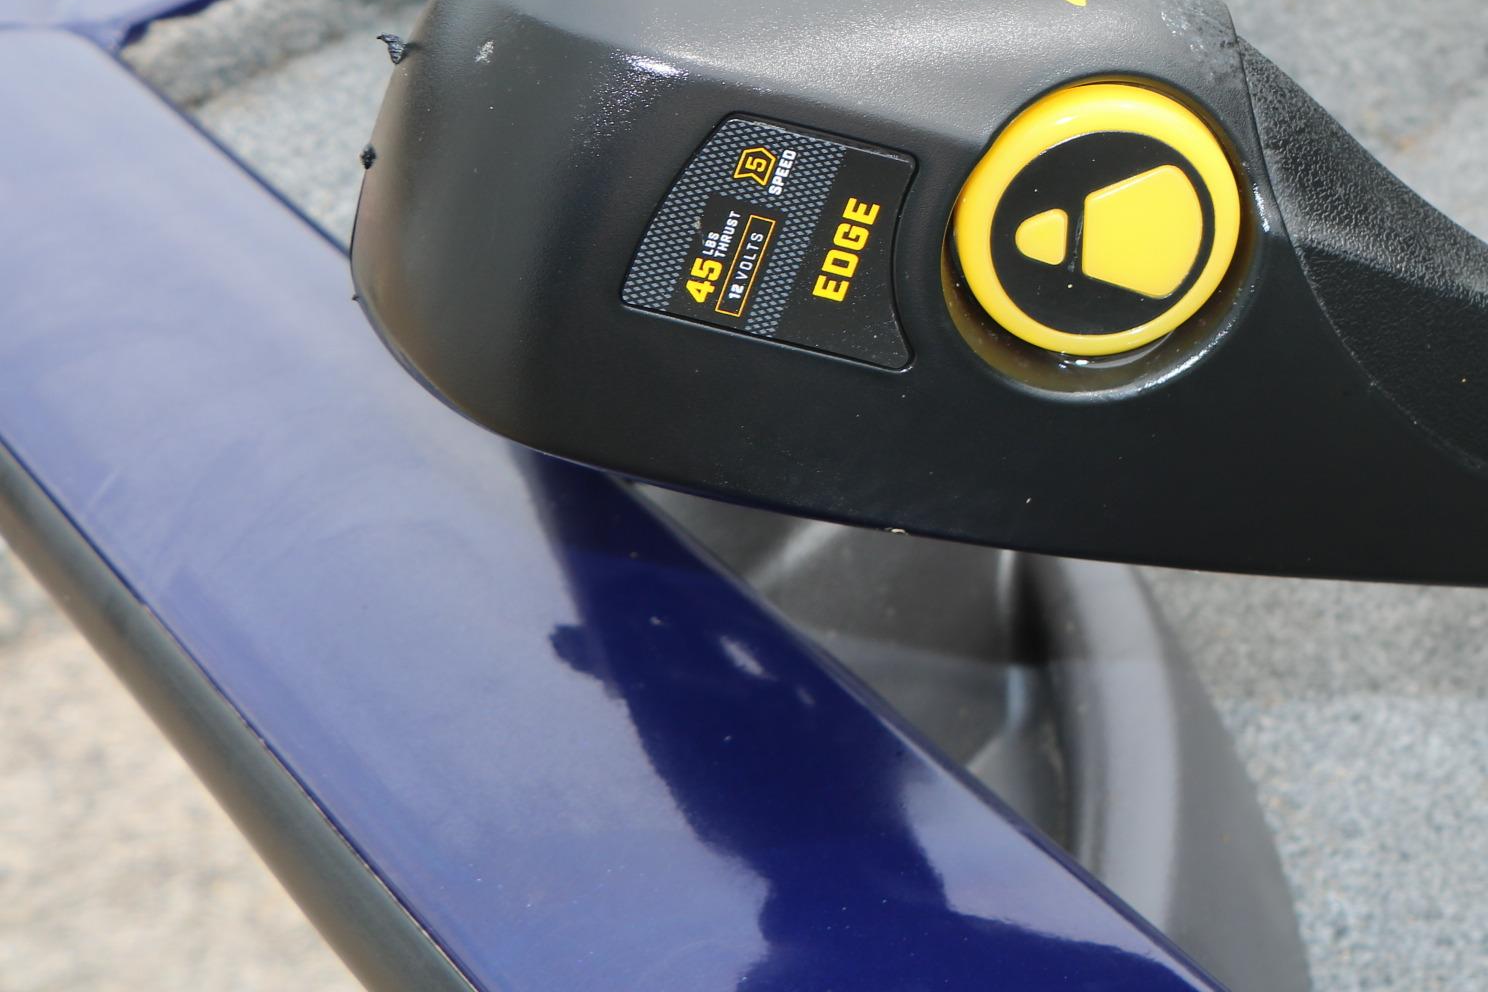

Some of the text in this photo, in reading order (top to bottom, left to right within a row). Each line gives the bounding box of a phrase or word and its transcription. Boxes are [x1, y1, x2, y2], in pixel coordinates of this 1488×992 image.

[744, 156, 767, 173] 5
[768, 149, 797, 196] SPEED
[702, 231, 720, 256] LBS
[714, 210, 742, 258] THRUST
[812, 197, 881, 302] EDGE
[685, 257, 723, 303] 45
[728, 232, 764, 300] 12 VOLTS
